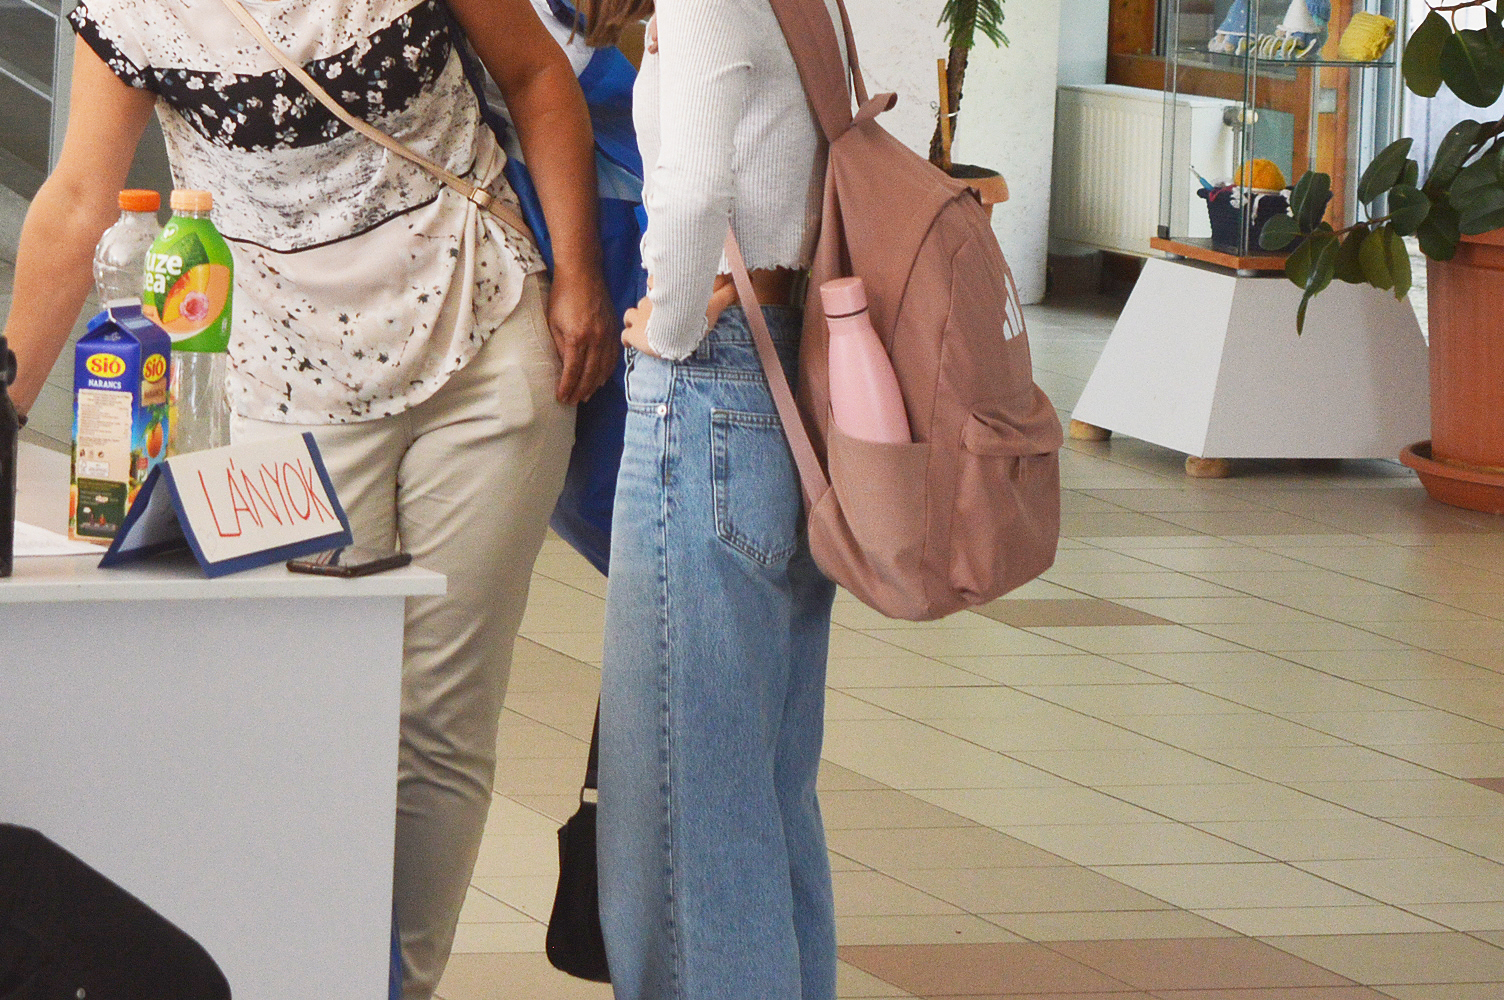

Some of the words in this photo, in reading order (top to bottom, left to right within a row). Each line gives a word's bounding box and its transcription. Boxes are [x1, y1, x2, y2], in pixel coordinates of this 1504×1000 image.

[144, 244, 183, 276] uze
[144, 273, 167, 294] ea
[88, 379, 122, 390] NARANCS
[197, 457, 335, 538] LÁNYOK
